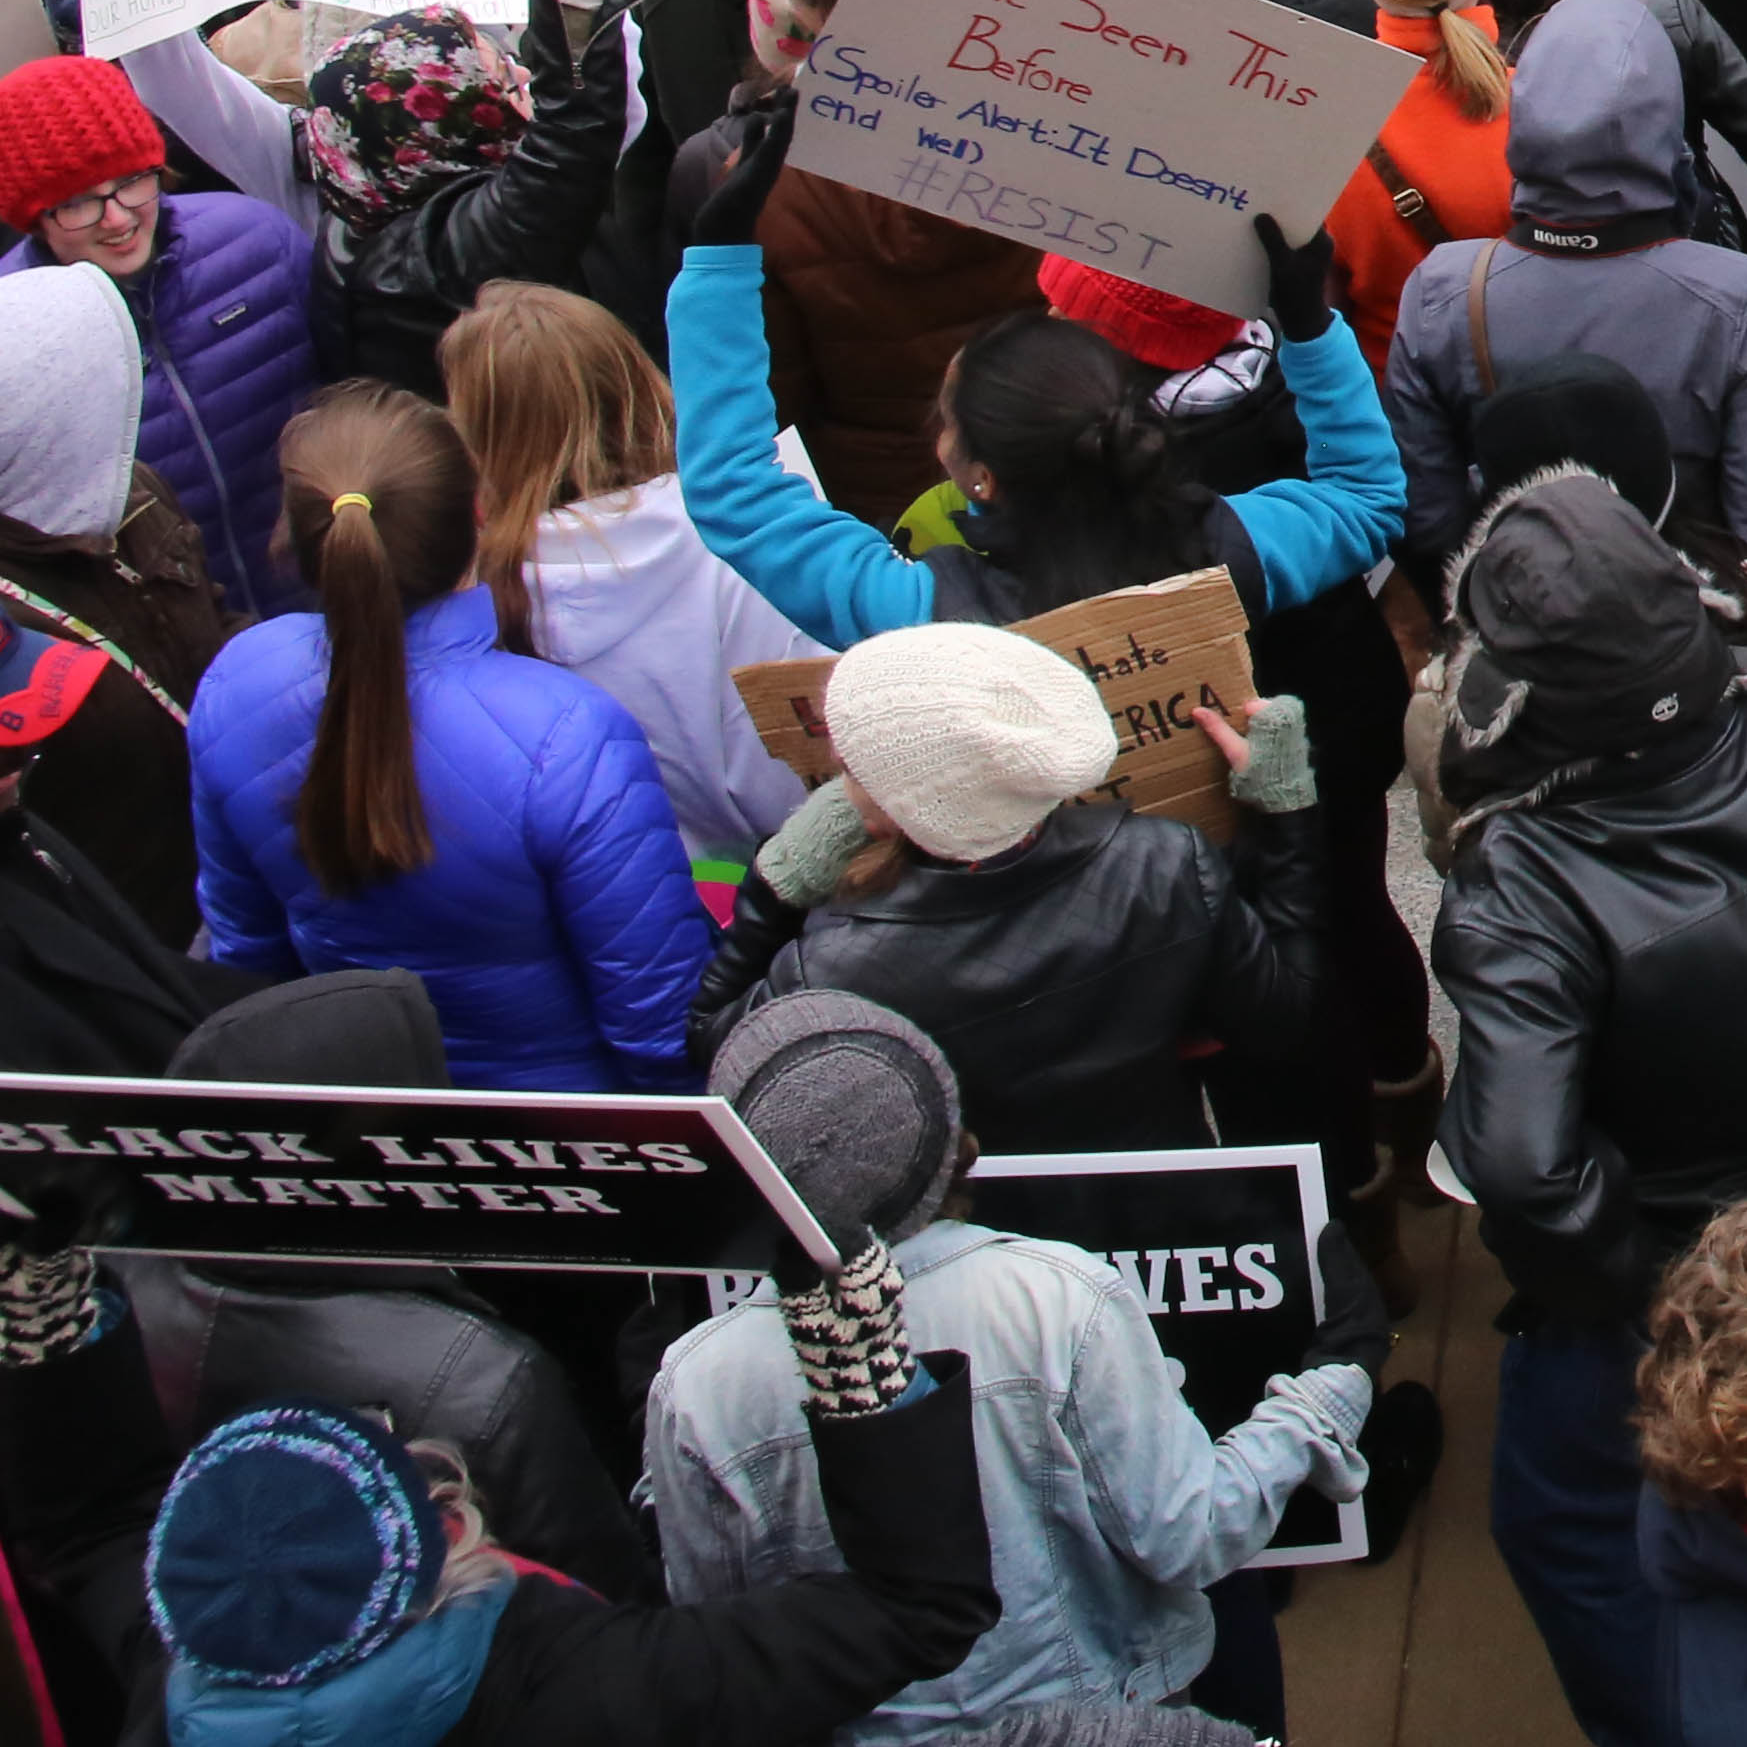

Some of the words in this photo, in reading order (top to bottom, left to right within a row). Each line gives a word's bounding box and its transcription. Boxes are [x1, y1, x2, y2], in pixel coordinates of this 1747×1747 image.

[86, 2, 120, 34] OUR
[946, 14, 1093, 105] Before
[1227, 28, 1319, 108] This
[810, 92, 881, 131] end
[892, 153, 1173, 271] #RESIST
[1124, 146, 1251, 212] Doesn't
[1533, 228, 1599, 250] Canon
[1117, 684, 1232, 755] ERICA
[0, 1120, 338, 1168] BLACK
[361, 1135, 710, 1173] LIVES
[144, 1171, 621, 1216] MATTER
[1111, 1242, 1286, 1316] VES
